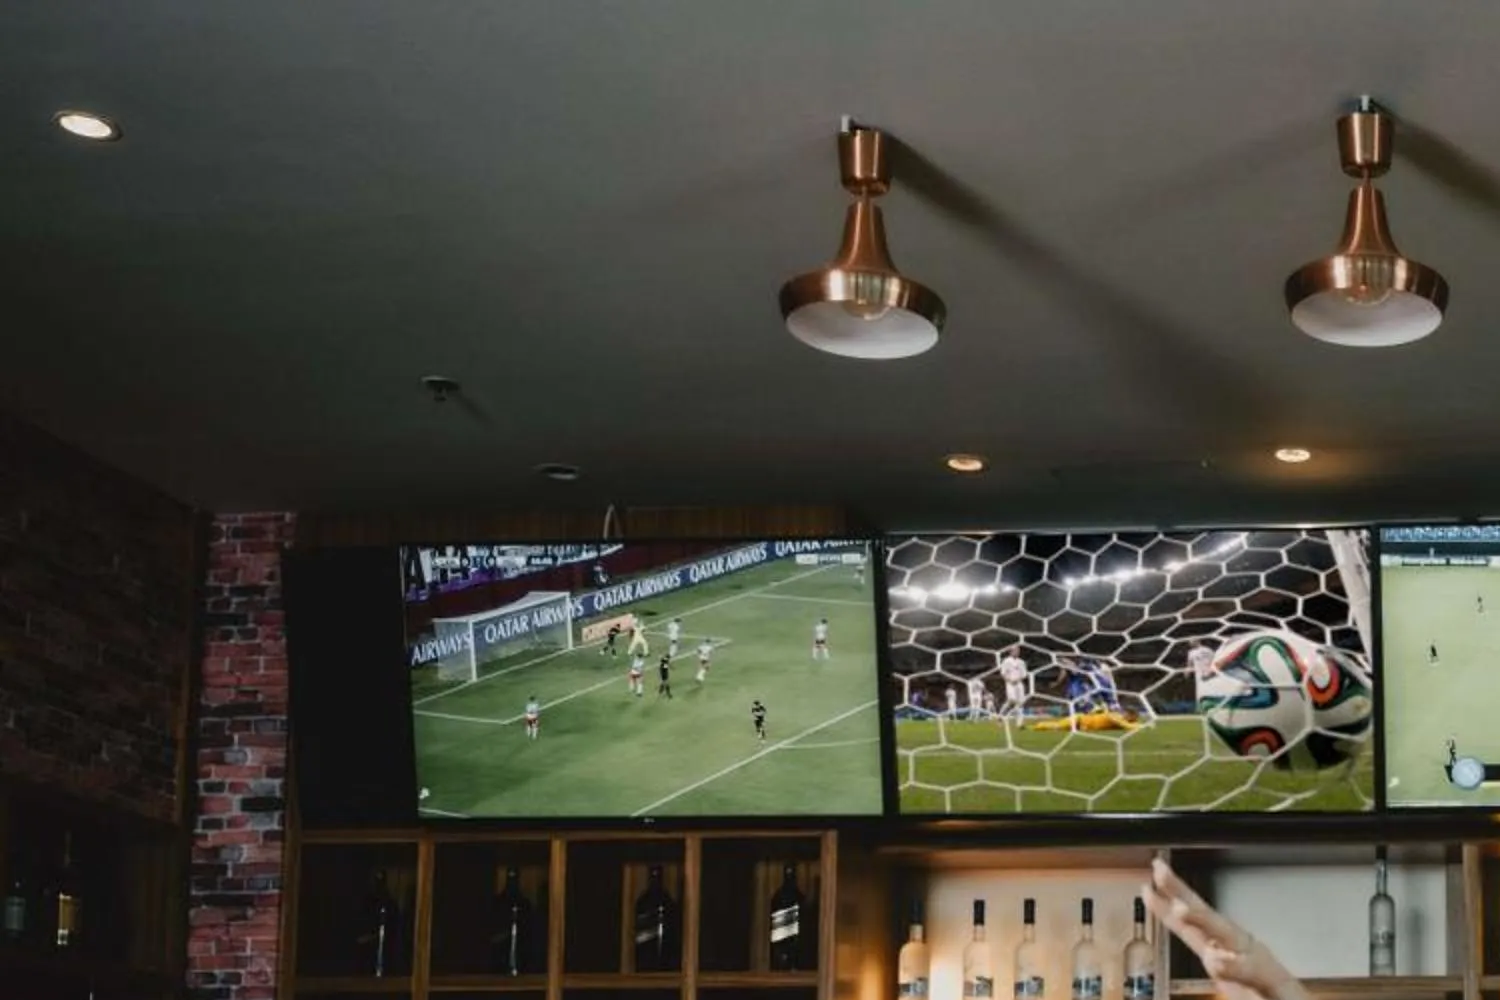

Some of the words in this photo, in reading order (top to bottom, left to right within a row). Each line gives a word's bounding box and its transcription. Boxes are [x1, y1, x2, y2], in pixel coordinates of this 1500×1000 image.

[689, 553, 725, 583] QATAR
[724, 543, 768, 572] AIRWAYS
[593, 586, 634, 611] QATAR
[634, 570, 682, 599] AIRWAYS
[411, 632, 472, 666] AIRWAYS
[484, 617, 530, 644] QATAR
